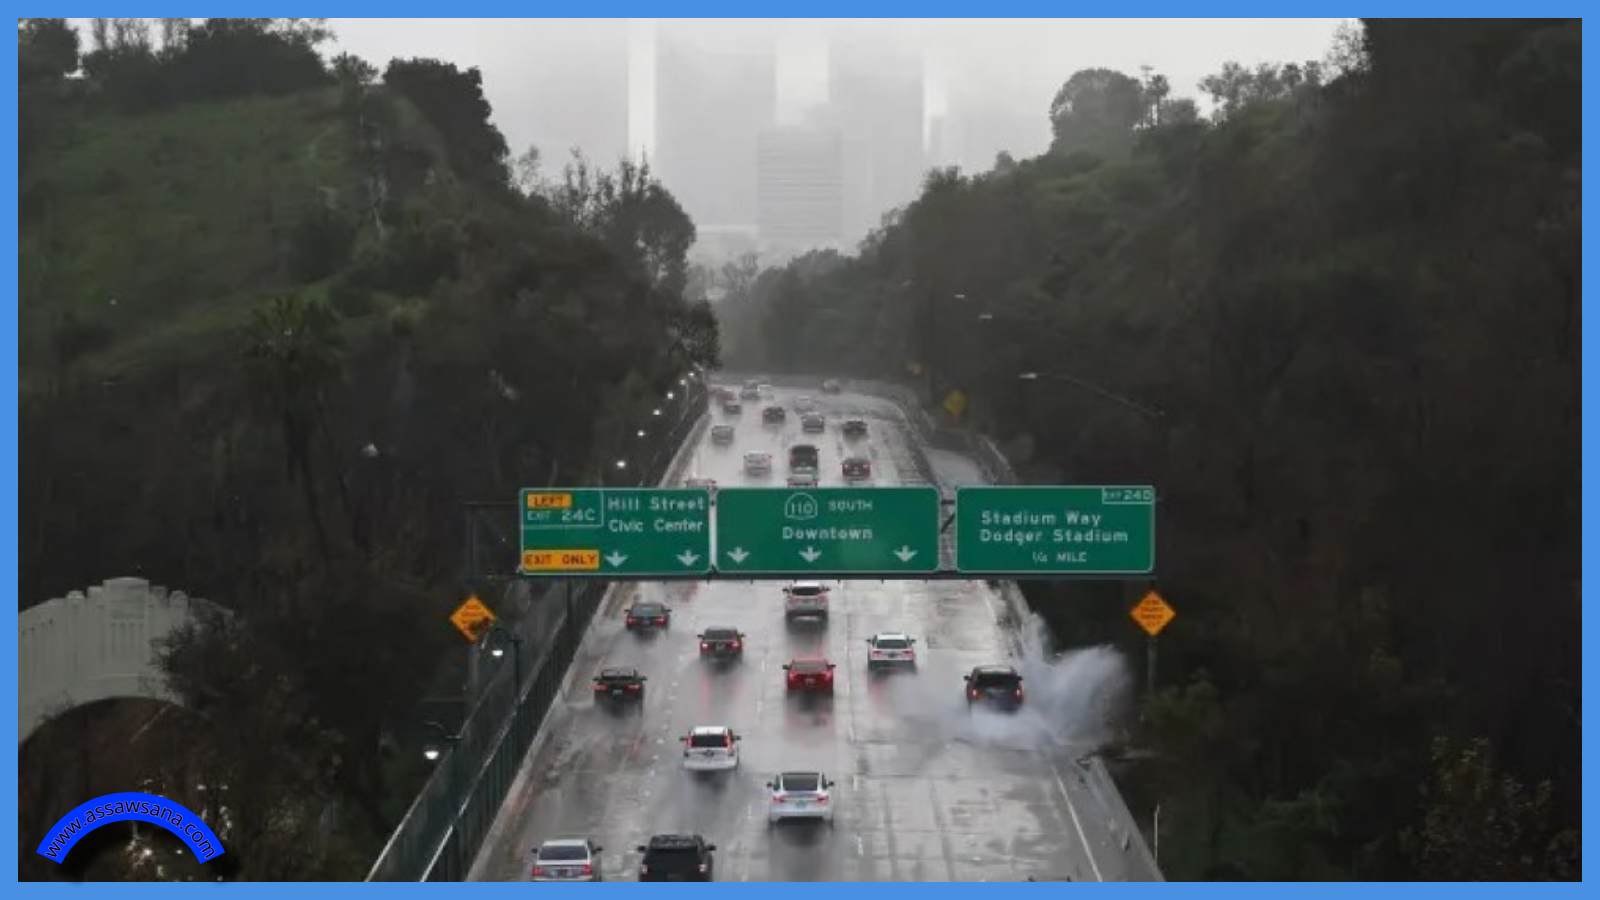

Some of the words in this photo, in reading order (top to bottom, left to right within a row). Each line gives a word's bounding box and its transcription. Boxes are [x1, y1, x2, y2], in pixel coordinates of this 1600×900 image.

[533, 495, 564, 507] LEFT
[608, 497, 639, 510] Hill
[650, 496, 704, 511] Street
[791, 502, 813, 515] 110
[828, 499, 873, 511] SOUTH
[561, 509, 595, 522] 24C
[981, 511, 1056, 525] Stadium
[1066, 511, 1102, 527] Way
[608, 519, 643, 532] Civic
[654, 519, 703, 532] Center
[782, 526, 873, 540] Downtown
[979, 529, 1043, 546] Dodger
[1053, 528, 1129, 543] Stadium
[525, 554, 552, 565] EXIT
[562, 554, 596, 565] ONLY
[1056, 551, 1087, 562] MILE
